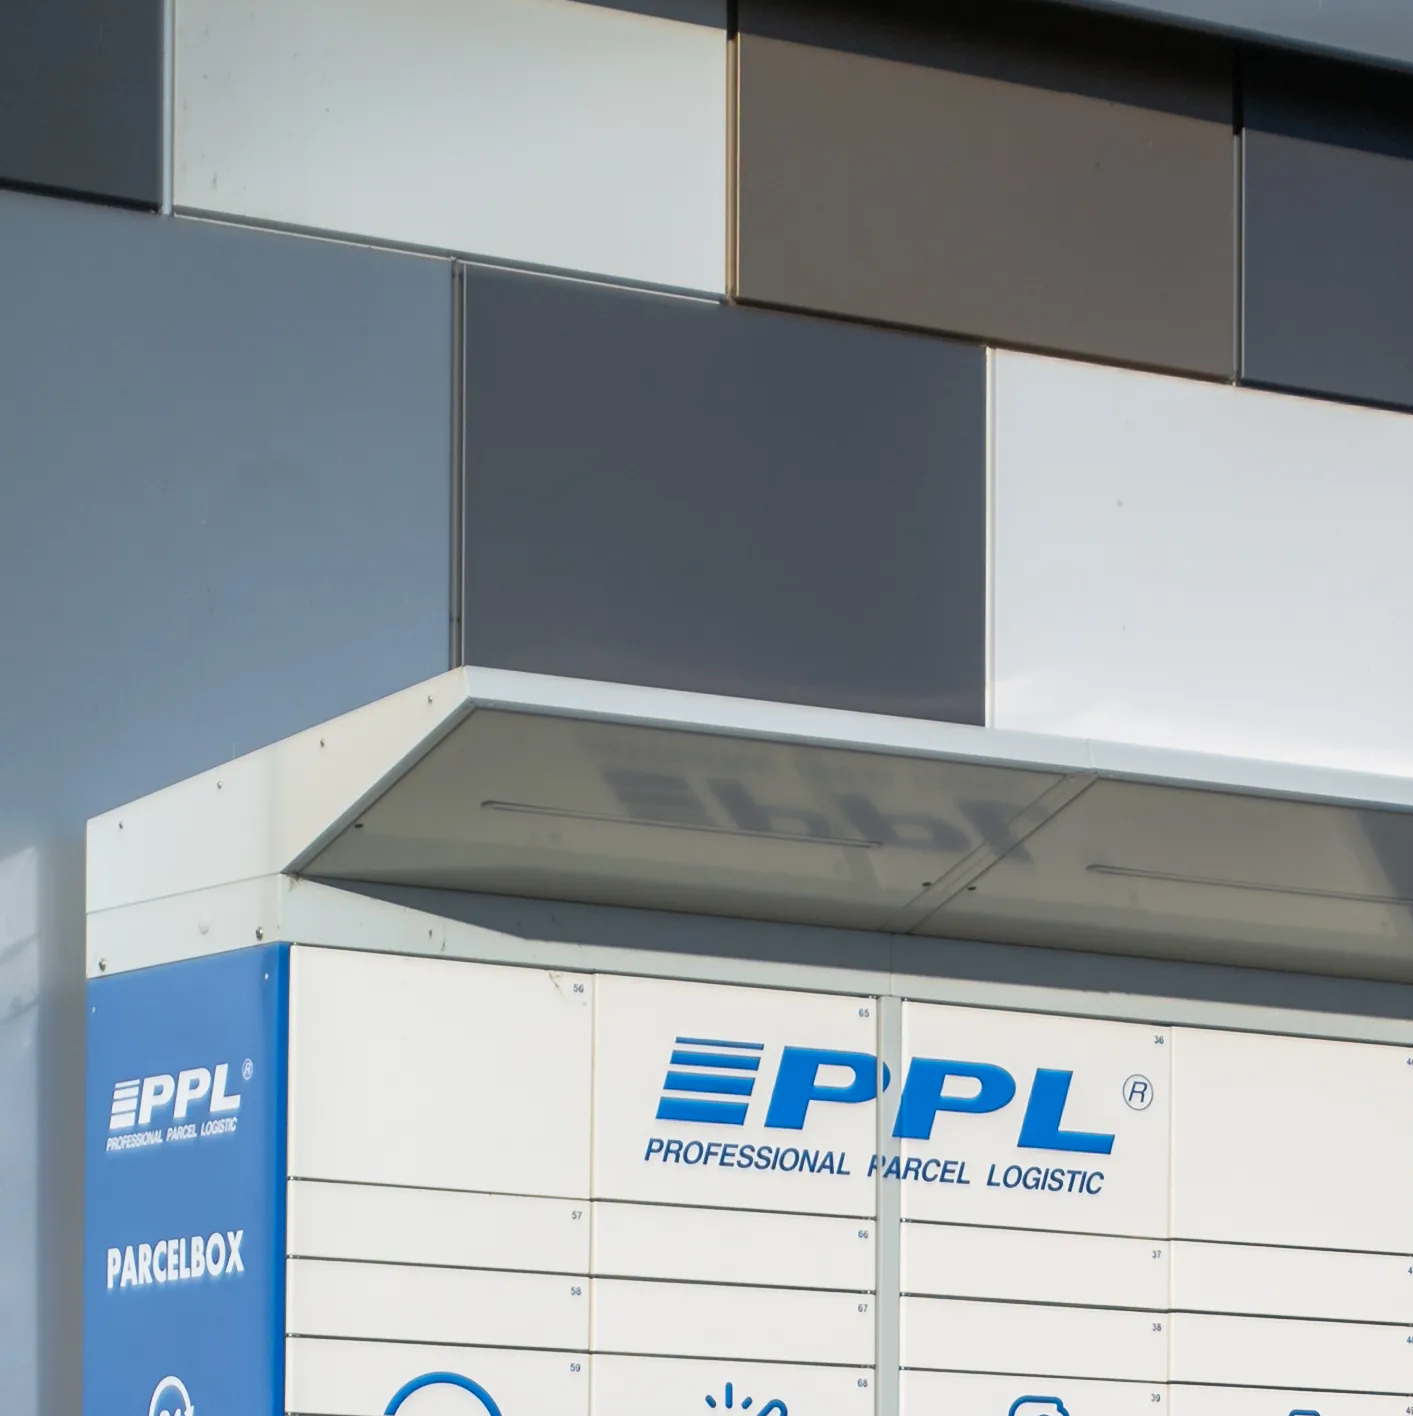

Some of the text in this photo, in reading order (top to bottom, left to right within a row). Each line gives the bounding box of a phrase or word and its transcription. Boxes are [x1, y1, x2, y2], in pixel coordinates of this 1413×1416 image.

[106, 1116, 238, 1152] PROFESSIONAL PARCEL LOGISTIC
[644, 1137, 1106, 1196] PROFESSIONAL PARCEL LOGISTIC
[572, 1211, 582, 1220] 57
[107, 1229, 245, 1289] PARCELBOX
[1152, 1250, 1161, 1259] 37
[858, 1304, 868, 1312] 67
[570, 1363, 581, 1372] 59
[857, 1379, 868, 1387] 68
[1152, 1394, 1160, 1402] 39
